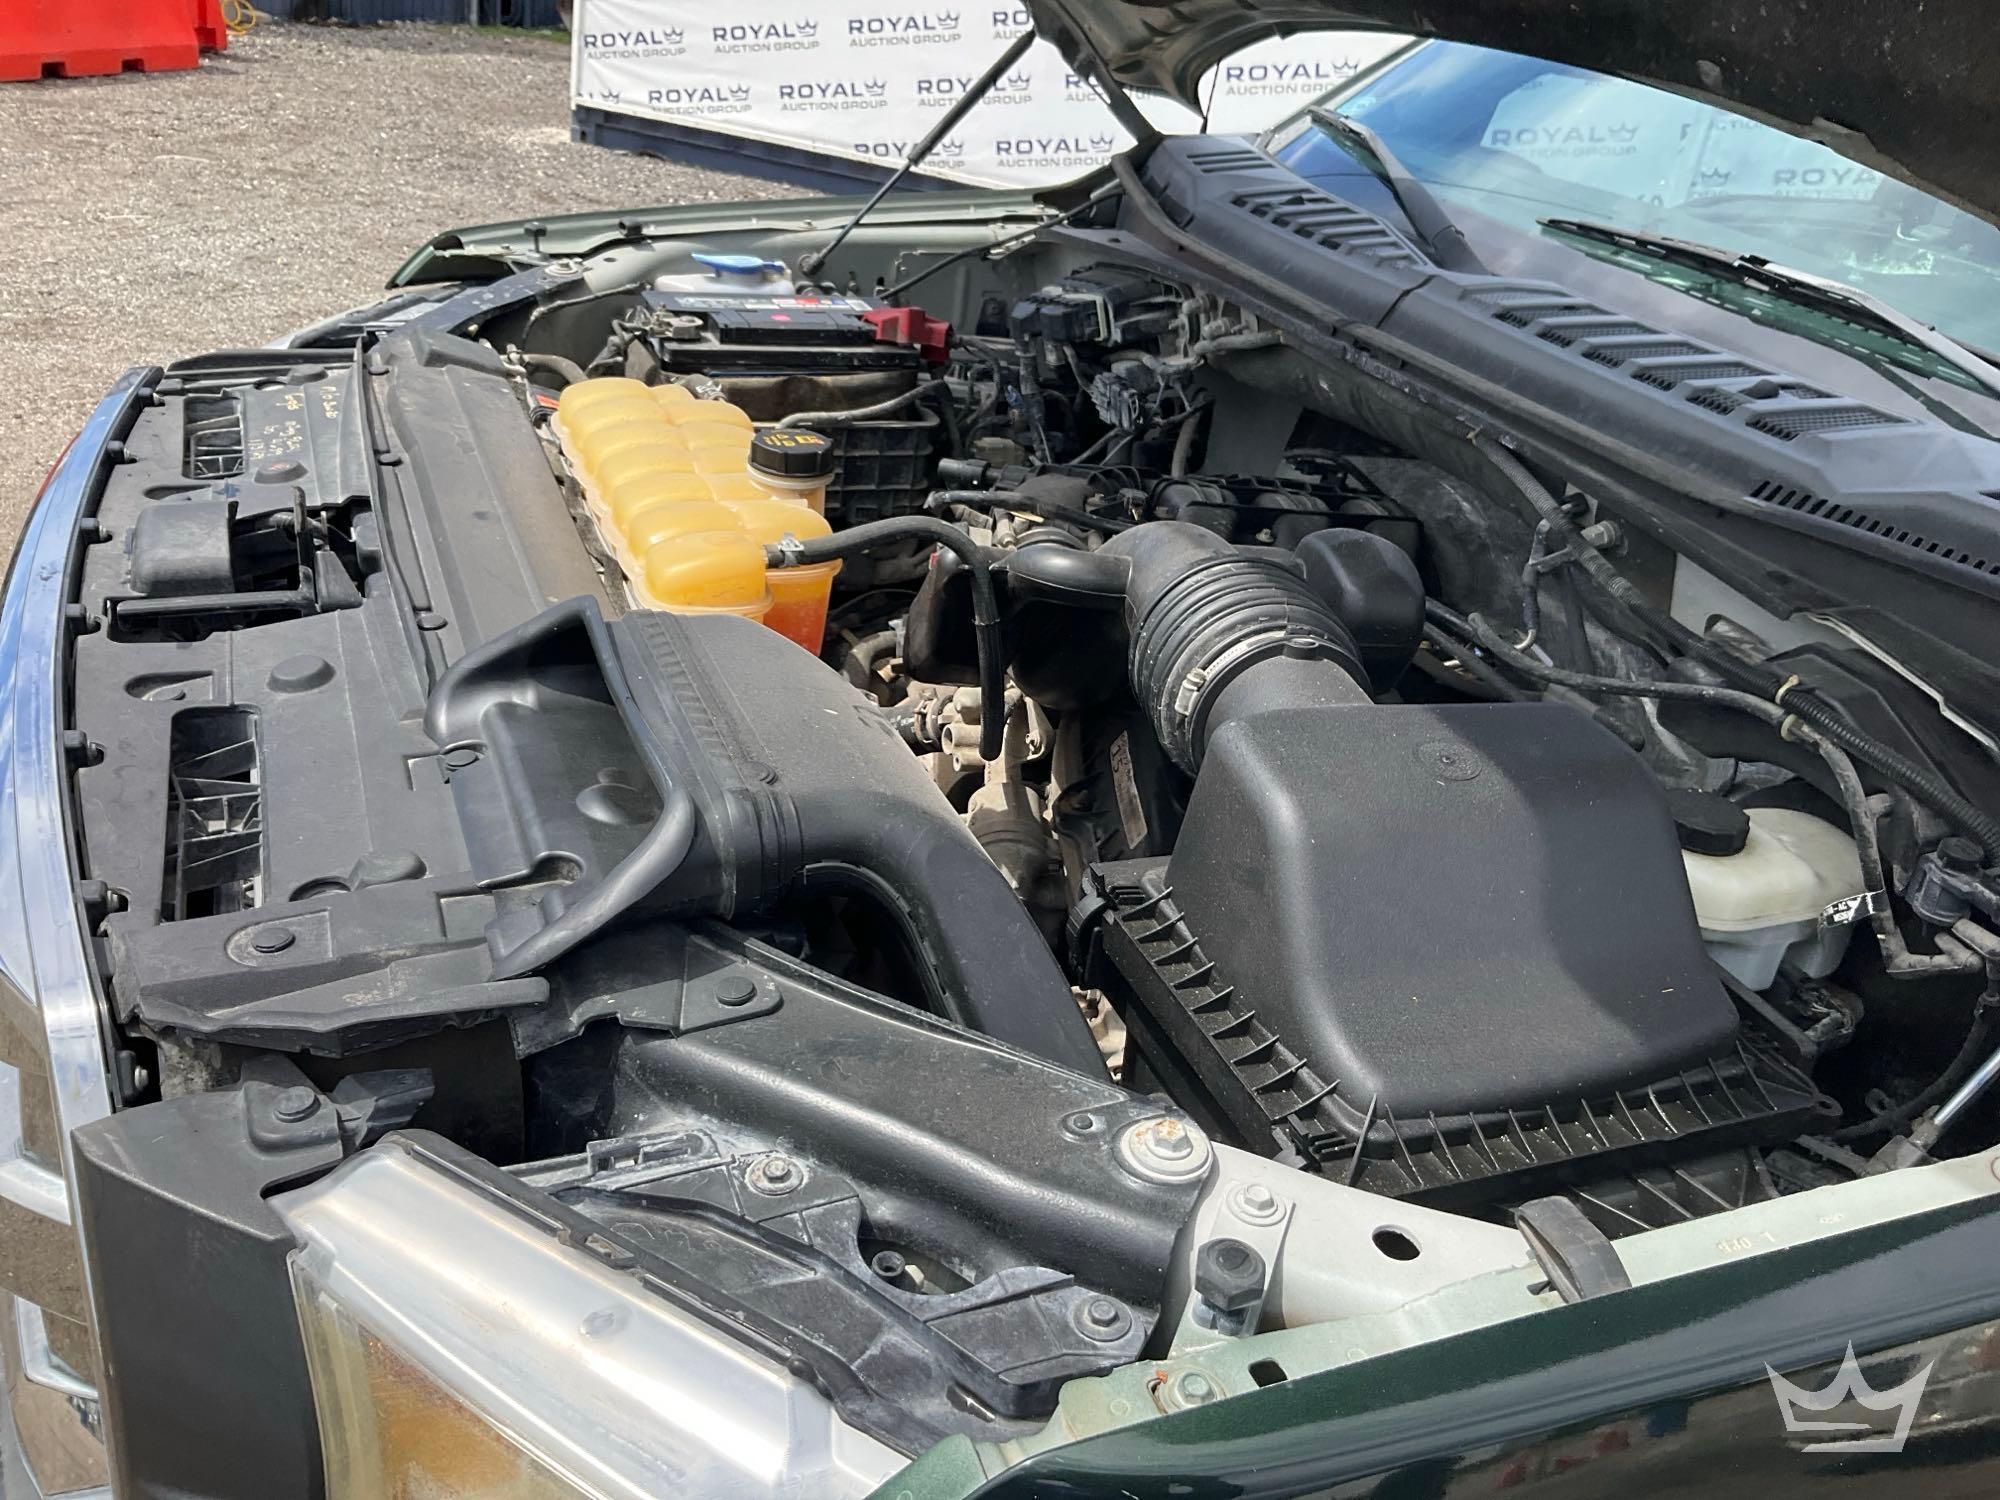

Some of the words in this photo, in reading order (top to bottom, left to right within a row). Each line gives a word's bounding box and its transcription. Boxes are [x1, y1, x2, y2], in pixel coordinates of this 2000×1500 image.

[713, 22, 796, 42] ROYAL
[849, 15, 936, 35] ROYAL
[584, 31, 663, 49] ROYAL
[714, 42, 772, 54] AUCTION
[774, 40, 820, 52] GROUP
[849, 36, 911, 48] AUCTION
[913, 33, 962, 45] GROUP
[586, 48, 641, 60] AUCTION
[643, 47, 686, 58] GROUP
[1226, 63, 1330, 82] ROYAL
[649, 87, 729, 105] ROYAL
[780, 81, 863, 99] ROYAL
[1226, 84, 1298, 96] AUCTION
[1301, 83, 1336, 94] GRO
[706, 103, 753, 114] GROUP
[780, 100, 839, 112] AUCTION
[841, 99, 889, 110] GROUP
[982, 95, 1033, 105] GROUP
[1491, 126, 1606, 146] ROYAL
[996, 138, 1087, 155] ROYAL
[997, 157, 1060, 168] AUCTION
[1774, 168, 1877, 185] ROYA
